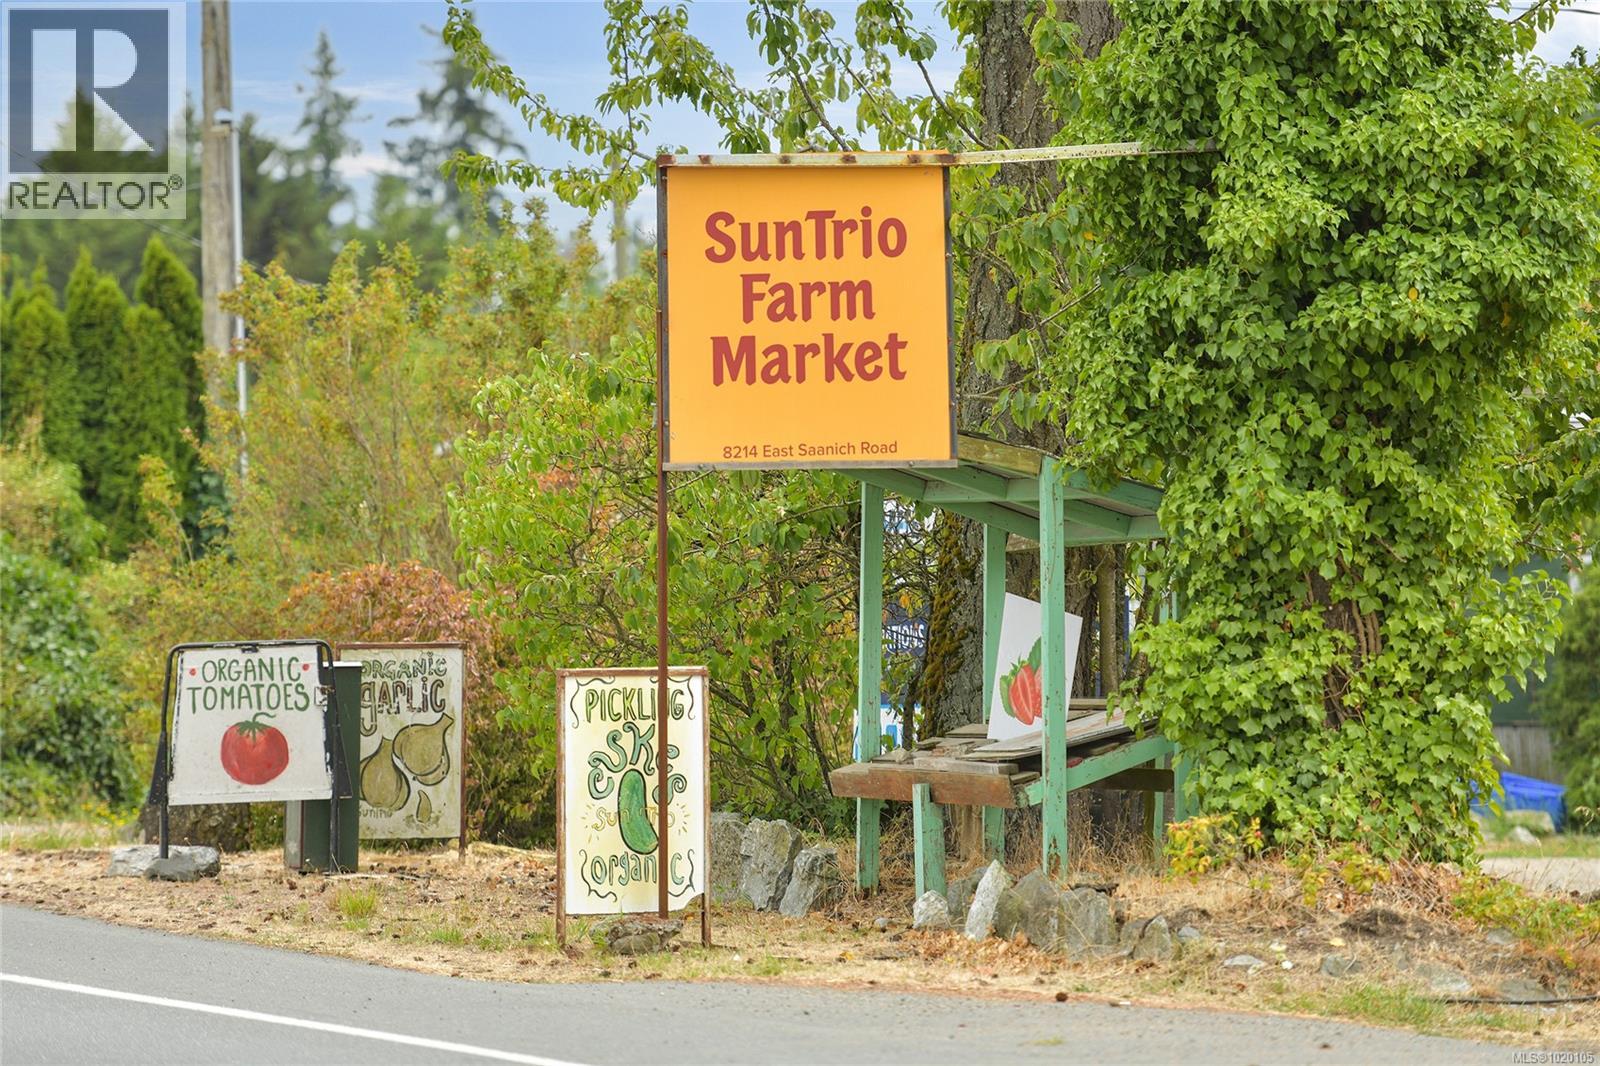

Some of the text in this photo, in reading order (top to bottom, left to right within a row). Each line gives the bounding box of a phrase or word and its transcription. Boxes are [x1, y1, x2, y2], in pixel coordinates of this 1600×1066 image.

[704, 205, 907, 264] SunTrio
[740, 273, 876, 324] Farm
[710, 333, 908, 387] Market
[723, 441, 898, 459] 8214 East Saanich Road
[202, 656, 301, 683] ORGANIC
[187, 683, 310, 713] TOMATOES
[585, 687, 685, 723] PICKLIG
[590, 851, 685, 887] organc
